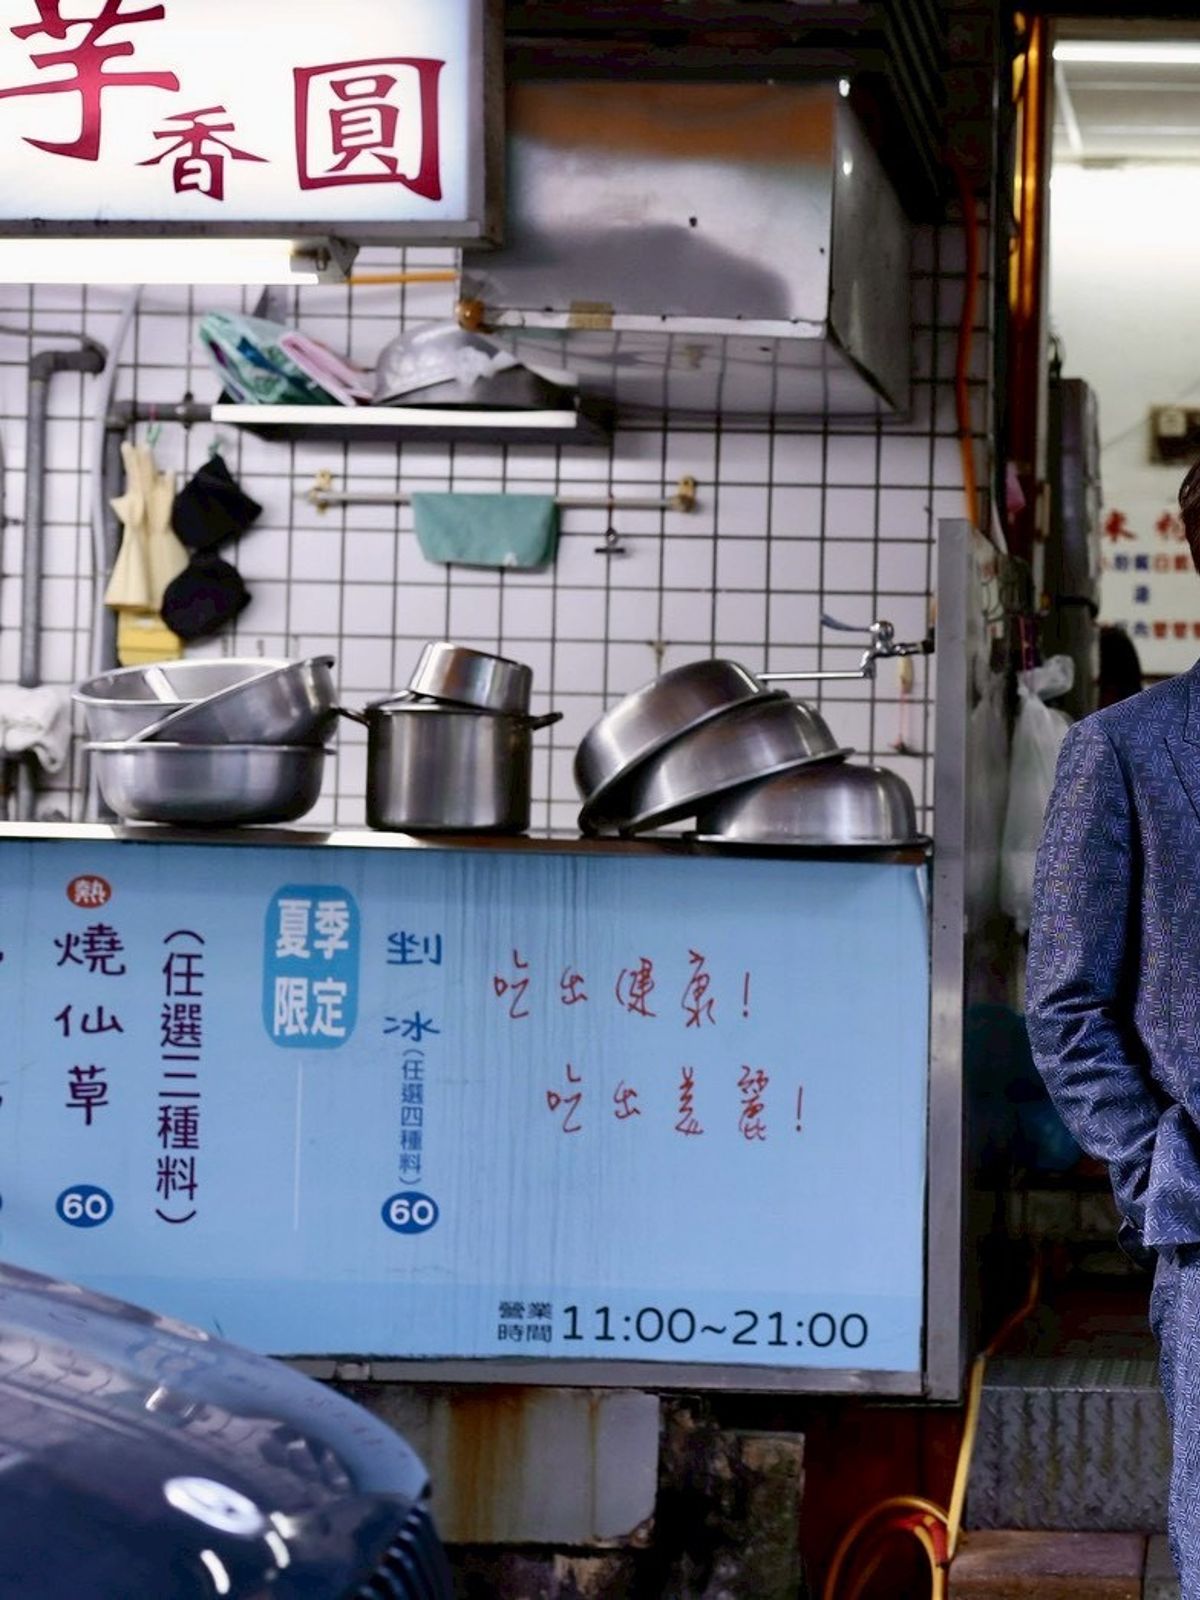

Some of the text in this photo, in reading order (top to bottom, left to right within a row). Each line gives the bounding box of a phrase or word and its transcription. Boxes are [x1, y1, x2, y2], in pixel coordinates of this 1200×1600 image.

[74, 879, 107, 904] 熱
[274, 897, 351, 961] 夏季
[53, 922, 127, 1127] 燒仙草
[272, 976, 348, 1038] 限定
[155, 929, 206, 1225] (任選三種料)
[397, 1047, 425, 1187] (任選四種料)
[62, 1193, 109, 1220] 60
[388, 1200, 435, 1227] 60
[497, 1324, 553, 1344] 時間
[499, 1301, 554, 1321] 營業
[562, 1304, 870, 1350] 11:00~21:00
